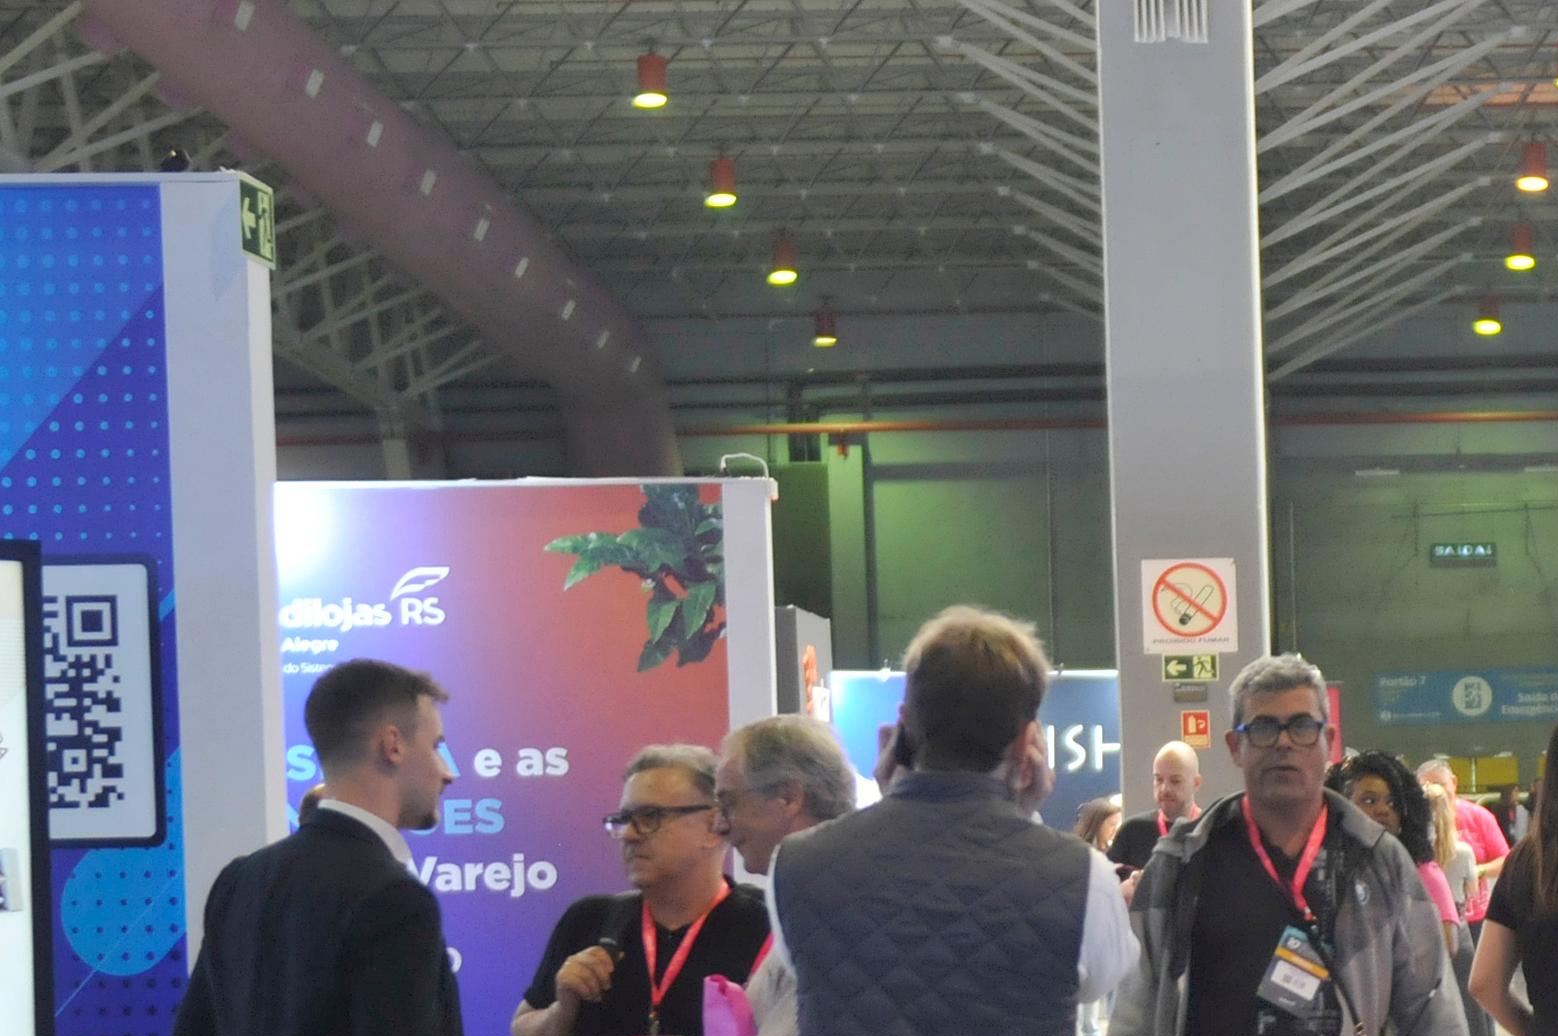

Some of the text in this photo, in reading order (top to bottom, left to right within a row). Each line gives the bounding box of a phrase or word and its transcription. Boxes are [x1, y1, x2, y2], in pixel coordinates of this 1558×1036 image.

[401, 597, 446, 626] RS
[282, 636, 339, 654] Alegre
[283, 662, 299, 674] do
[474, 748, 502, 777] e
[516, 747, 569, 776] as
